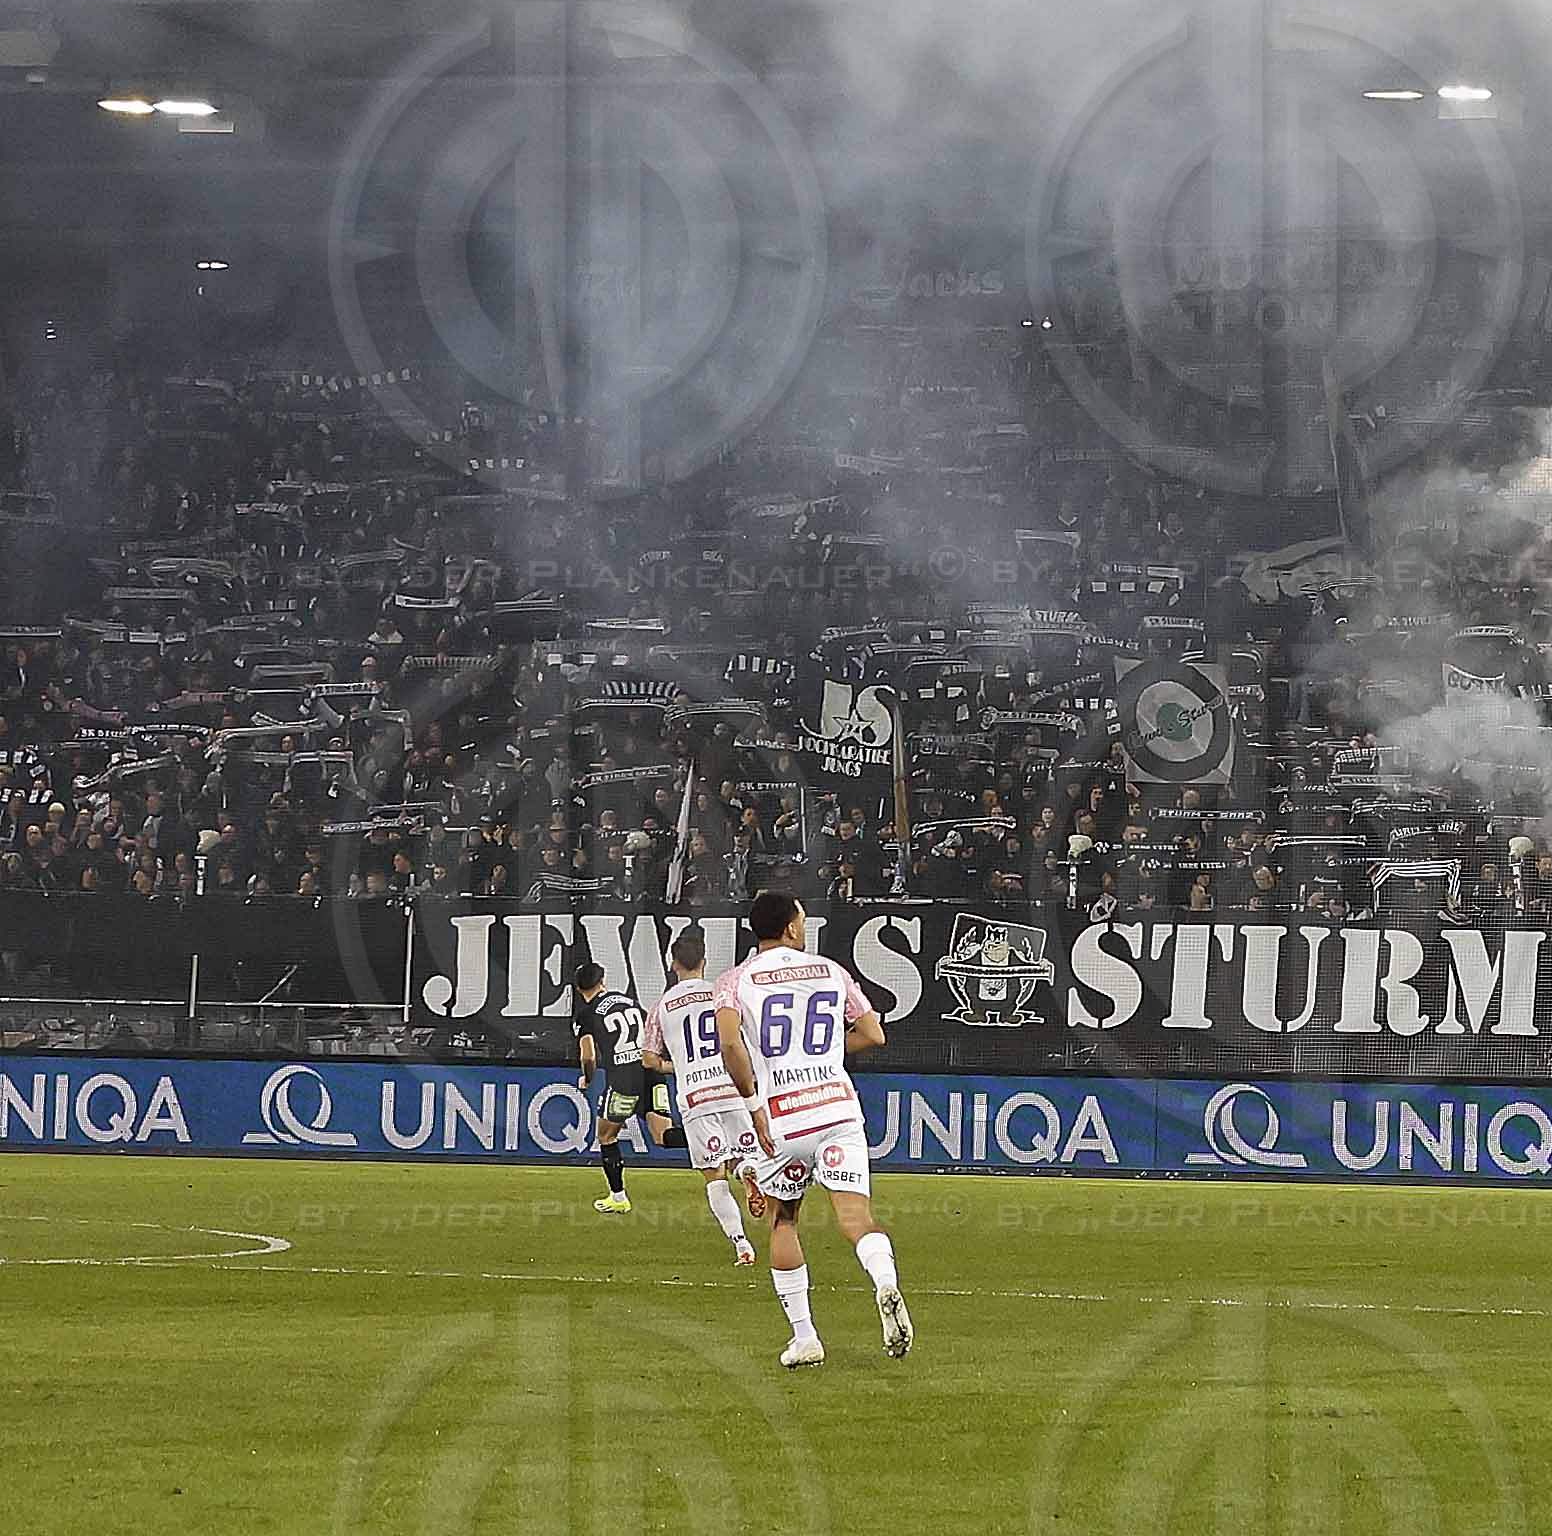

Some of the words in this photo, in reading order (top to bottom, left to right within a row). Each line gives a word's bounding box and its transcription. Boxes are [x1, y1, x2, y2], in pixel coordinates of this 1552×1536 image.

[773, 965, 830, 983] GENERALI
[1067, 921, 1547, 1036] STURM
[760, 990, 839, 1059] 66
